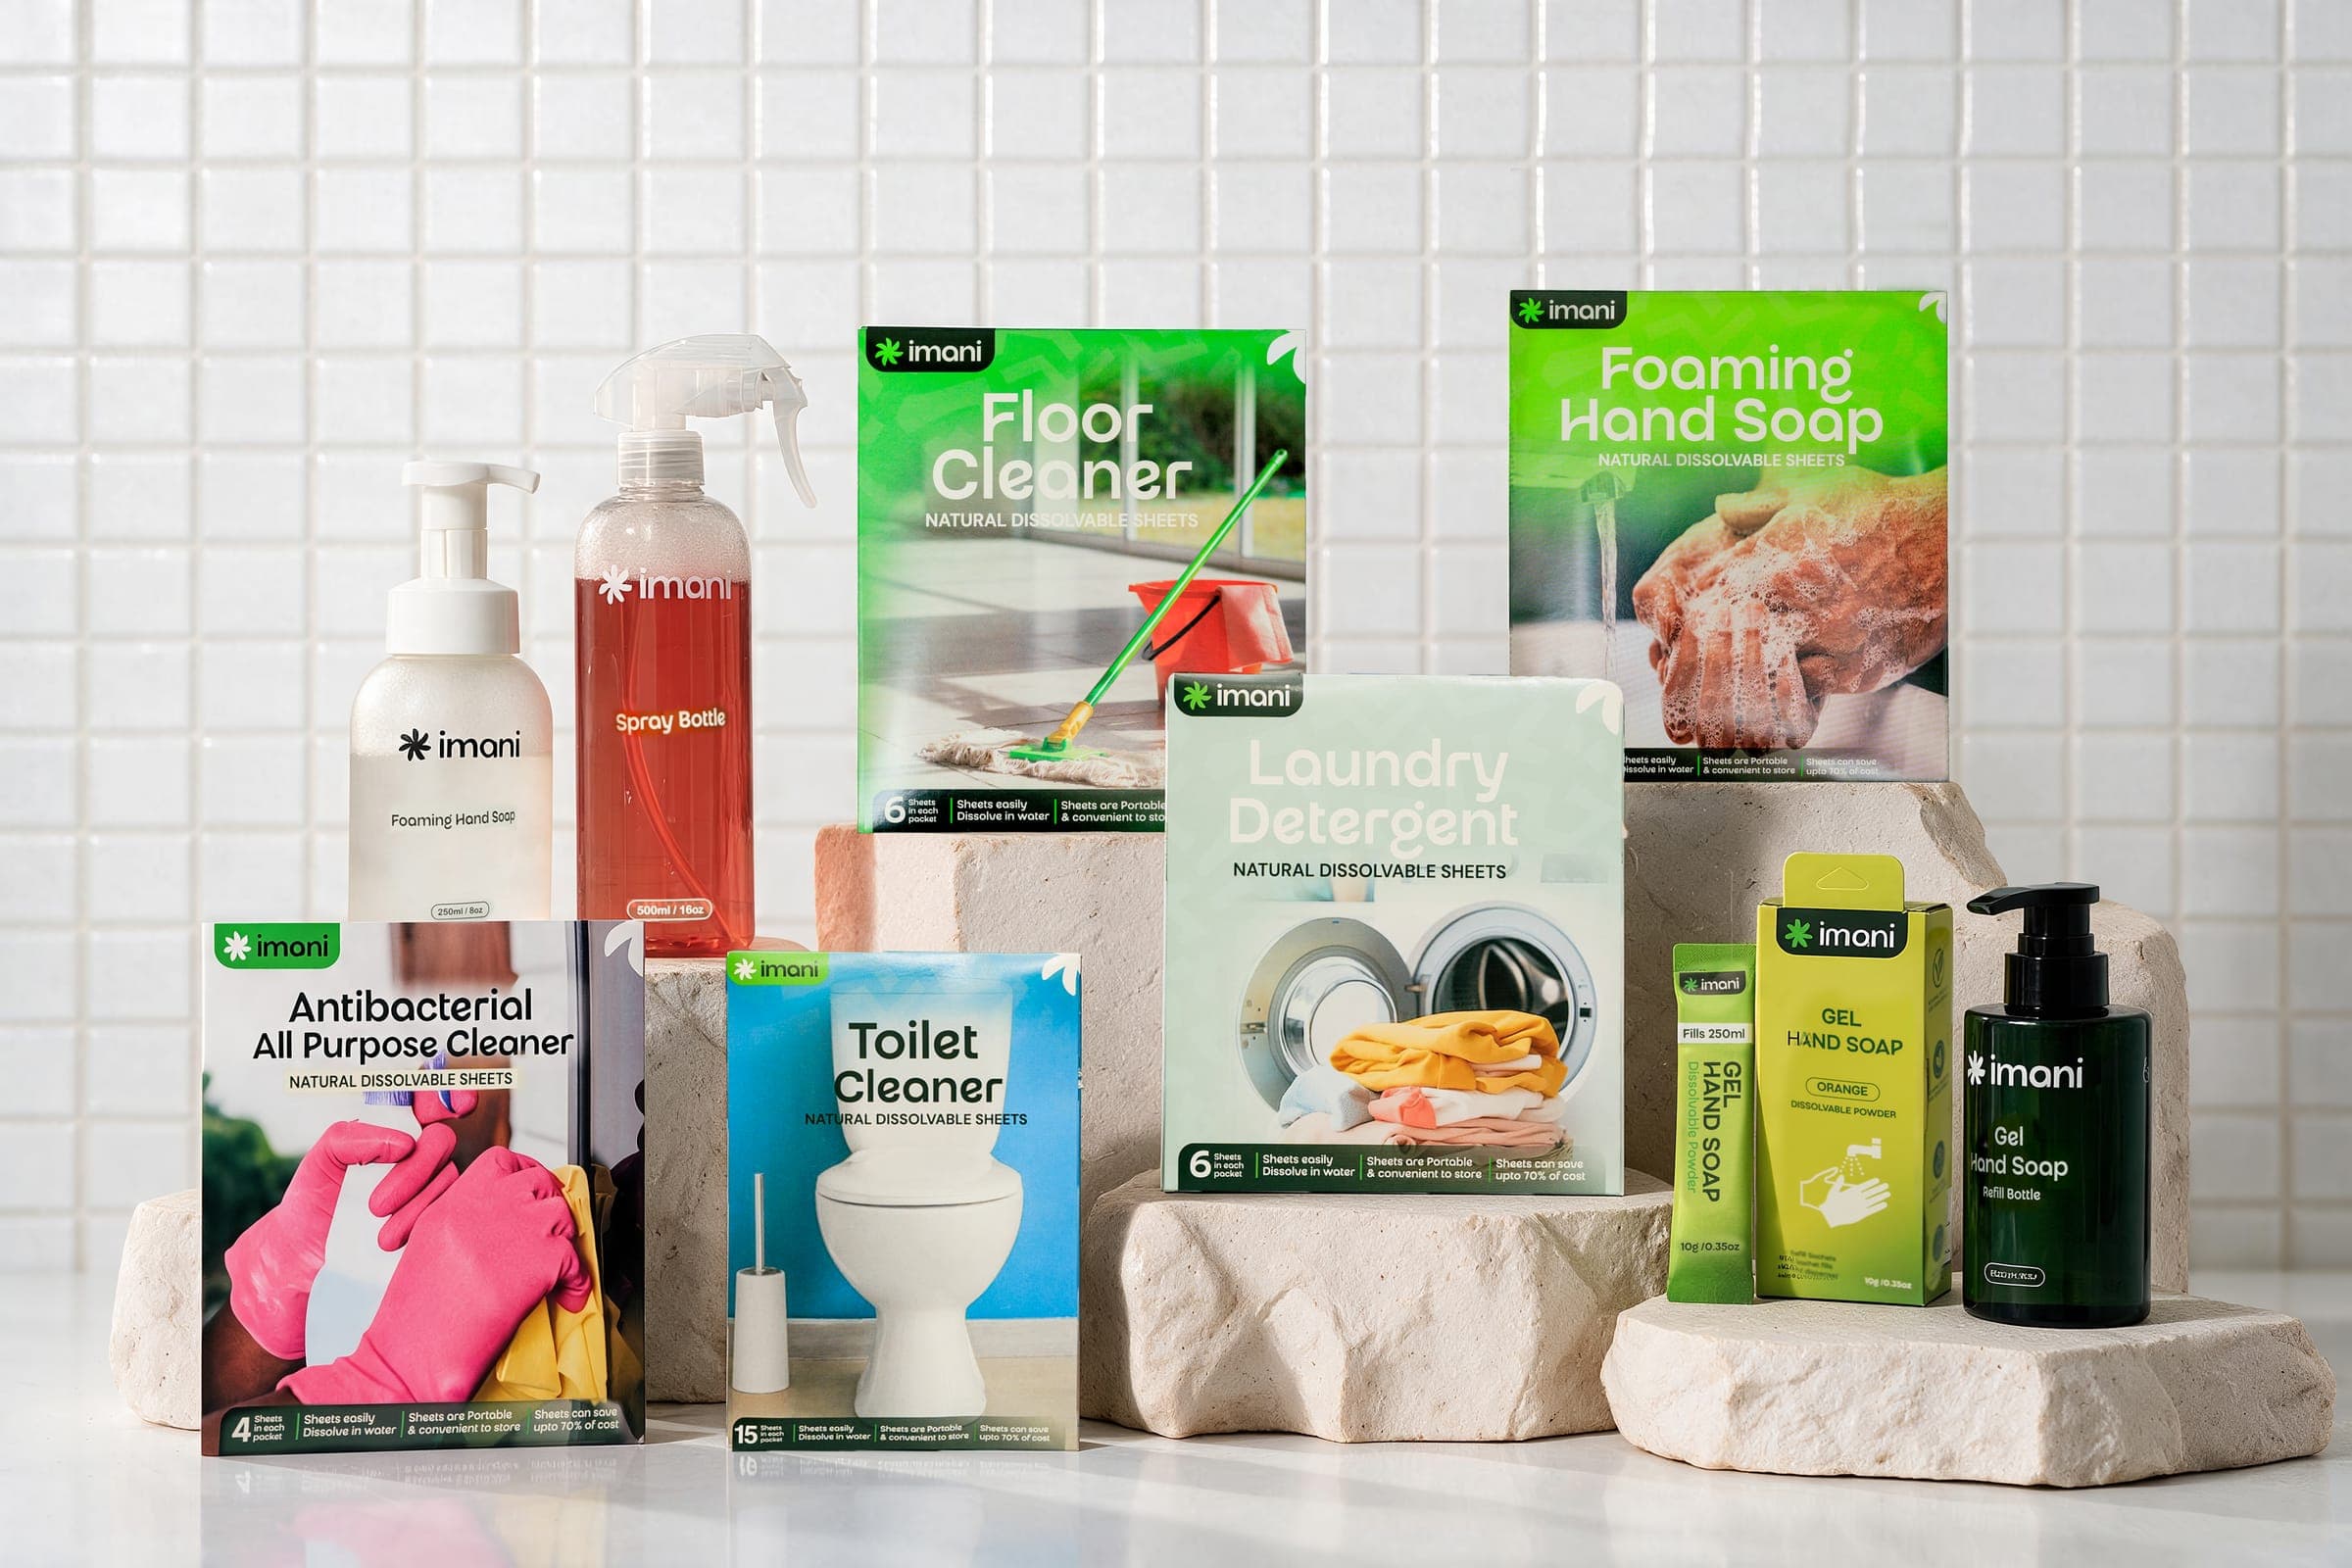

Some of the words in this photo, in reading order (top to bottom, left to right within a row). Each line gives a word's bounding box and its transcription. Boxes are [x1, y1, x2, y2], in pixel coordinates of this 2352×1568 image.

[1548, 300, 1615, 320] imani
[908, 340, 982, 363] imani
[1601, 344, 1854, 404] Foaming
[983, 389, 1153, 443] Floor
[1561, 395, 1715, 442] Hand
[1735, 398, 1884, 455] Soap
[1598, 454, 1673, 466] NATURAL
[1676, 454, 1783, 466] DISSOLVABLE
[1786, 454, 1844, 466] SHEETS
[932, 446, 1194, 500] Cleaner
[925, 513, 1007, 527] NATURAL
[1011, 513, 1129, 527] DISSOLVABLE
[1134, 513, 1199, 527] SHEETS
[639, 571, 732, 600] imani
[1216, 684, 1291, 708] imani
[616, 712, 673, 738] Spray
[678, 708, 726, 730] Bottle
[439, 730, 520, 760] imani
[1650, 756, 1676, 765] easily
[1751, 757, 1788, 765] Portable
[1250, 738, 1509, 803] Laundry
[885, 797, 906, 823] 6
[957, 800, 993, 809] Sheets
[997, 801, 1027, 811] easily
[1061, 801, 1097, 809] Sheets
[391, 812, 453, 829] Foaming
[456, 810, 489, 826] Hand
[492, 808, 515, 825] Soap
[957, 811, 1002, 821] Dissolve
[1005, 811, 1014, 821] in
[1017, 812, 1050, 821] water
[1061, 812, 1069, 821] &
[1072, 812, 1132, 821] convenient
[1134, 812, 1147, 821] to
[1229, 798, 1518, 860] Detergent
[1233, 862, 1314, 877] NATURAL
[1319, 863, 1437, 878] DISSOLVABLE
[1441, 864, 1506, 879] SHEETS
[438, 906, 463, 916] 250ml
[637, 905, 669, 915] 500ml
[672, 905, 677, 915] /
[679, 905, 704, 915] 16oz
[1819, 921, 1895, 950] imani
[760, 960, 818, 977] imani
[1701, 977, 1740, 990] imani
[289, 988, 532, 1022] Antibacterial
[1821, 1007, 1861, 1027] GEL
[849, 1019, 978, 1059] Toilet
[1683, 1028, 1705, 1039] Fills
[1708, 1027, 1745, 1040] 250ml
[254, 1030, 293, 1059] All
[304, 1032, 437, 1064] Purpose
[446, 1027, 574, 1056] Cleaner
[1788, 1030, 1841, 1052] HAND
[1845, 1035, 1903, 1055] SOAP
[1990, 1054, 2083, 1089] imani
[289, 1074, 357, 1089] NATURAL
[361, 1073, 455, 1088] DISSOLVABLE
[459, 1072, 513, 1086] SHEETS
[834, 1068, 1003, 1103] Cleaner
[1724, 1061, 1741, 1108] GEL
[1816, 1081, 1868, 1097] ORANGE
[1687, 1061, 1697, 1138] Dissolvable
[1702, 1061, 1721, 1131] HAND
[1790, 1100, 1851, 1116] DISSOLVABLE
[1853, 1106, 1896, 1118] POWDER
[805, 1113, 872, 1125] NATURAL
[876, 1113, 971, 1125] DISSOLVABLE
[975, 1113, 1027, 1125] SHEETS
[1994, 1126, 2024, 1146] Gel
[1190, 1151, 1209, 1178] 6
[1262, 1154, 1298, 1165] Sheets
[1301, 1154, 1333, 1168] easily
[1367, 1156, 1402, 1167] Sheets
[1405, 1158, 1424, 1167] are
[1427, 1156, 1473, 1168] Portable
[1495, 1158, 1533, 1169] Sheets
[1535, 1160, 1553, 1170] can
[1557, 1160, 1584, 1170] save
[1686, 1142, 1697, 1194] Powder
[1702, 1136, 1721, 1202] SOAP
[1971, 1152, 2007, 1174] Hand
[2012, 1155, 2069, 1182] Soap
[1262, 1166, 1308, 1178] Dissolve
[1311, 1166, 1321, 1178] in
[1324, 1167, 1355, 1178] water
[1367, 1169, 1376, 1180] &
[1378, 1168, 1438, 1180] convenient
[1440, 1169, 1452, 1180] to
[1454, 1170, 1482, 1180] store
[1495, 1172, 1522, 1183] upto
[1524, 1171, 1546, 1181] 70%
[1548, 1171, 1560, 1181] of
[1562, 1172, 1586, 1181] cost
[1984, 1186, 2004, 1199] Refill
[2007, 1188, 2040, 1200] Bottle
[1680, 1242, 1698, 1254] 10g
[304, 1413, 340, 1424] Sheets
[343, 1413, 375, 1426] easily
[409, 1410, 444, 1422] Sheets
[447, 1411, 465, 1421] are
[467, 1409, 513, 1421] Portable
[534, 1408, 568, 1419] Sheets
[571, 1409, 590, 1418] can
[592, 1408, 617, 1418] save
[231, 1416, 252, 1442] 4
[303, 1426, 349, 1437] Dissolve
[351, 1426, 362, 1436] in
[364, 1425, 397, 1436] water
[408, 1425, 416, 1435] &
[417, 1423, 477, 1434] convenient
[480, 1422, 491, 1433] to
[494, 1422, 520, 1433] store
[534, 1421, 559, 1432] upto
[561, 1420, 583, 1431] 70%
[584, 1419, 597, 1431] of
[598, 1420, 619, 1430] cost
[799, 1424, 828, 1433] Sheets
[830, 1425, 854, 1435] easily
[734, 1426, 758, 1444] 15
[799, 1432, 834, 1441] Dissolve
[888, 1433, 937, 1442] convenient
